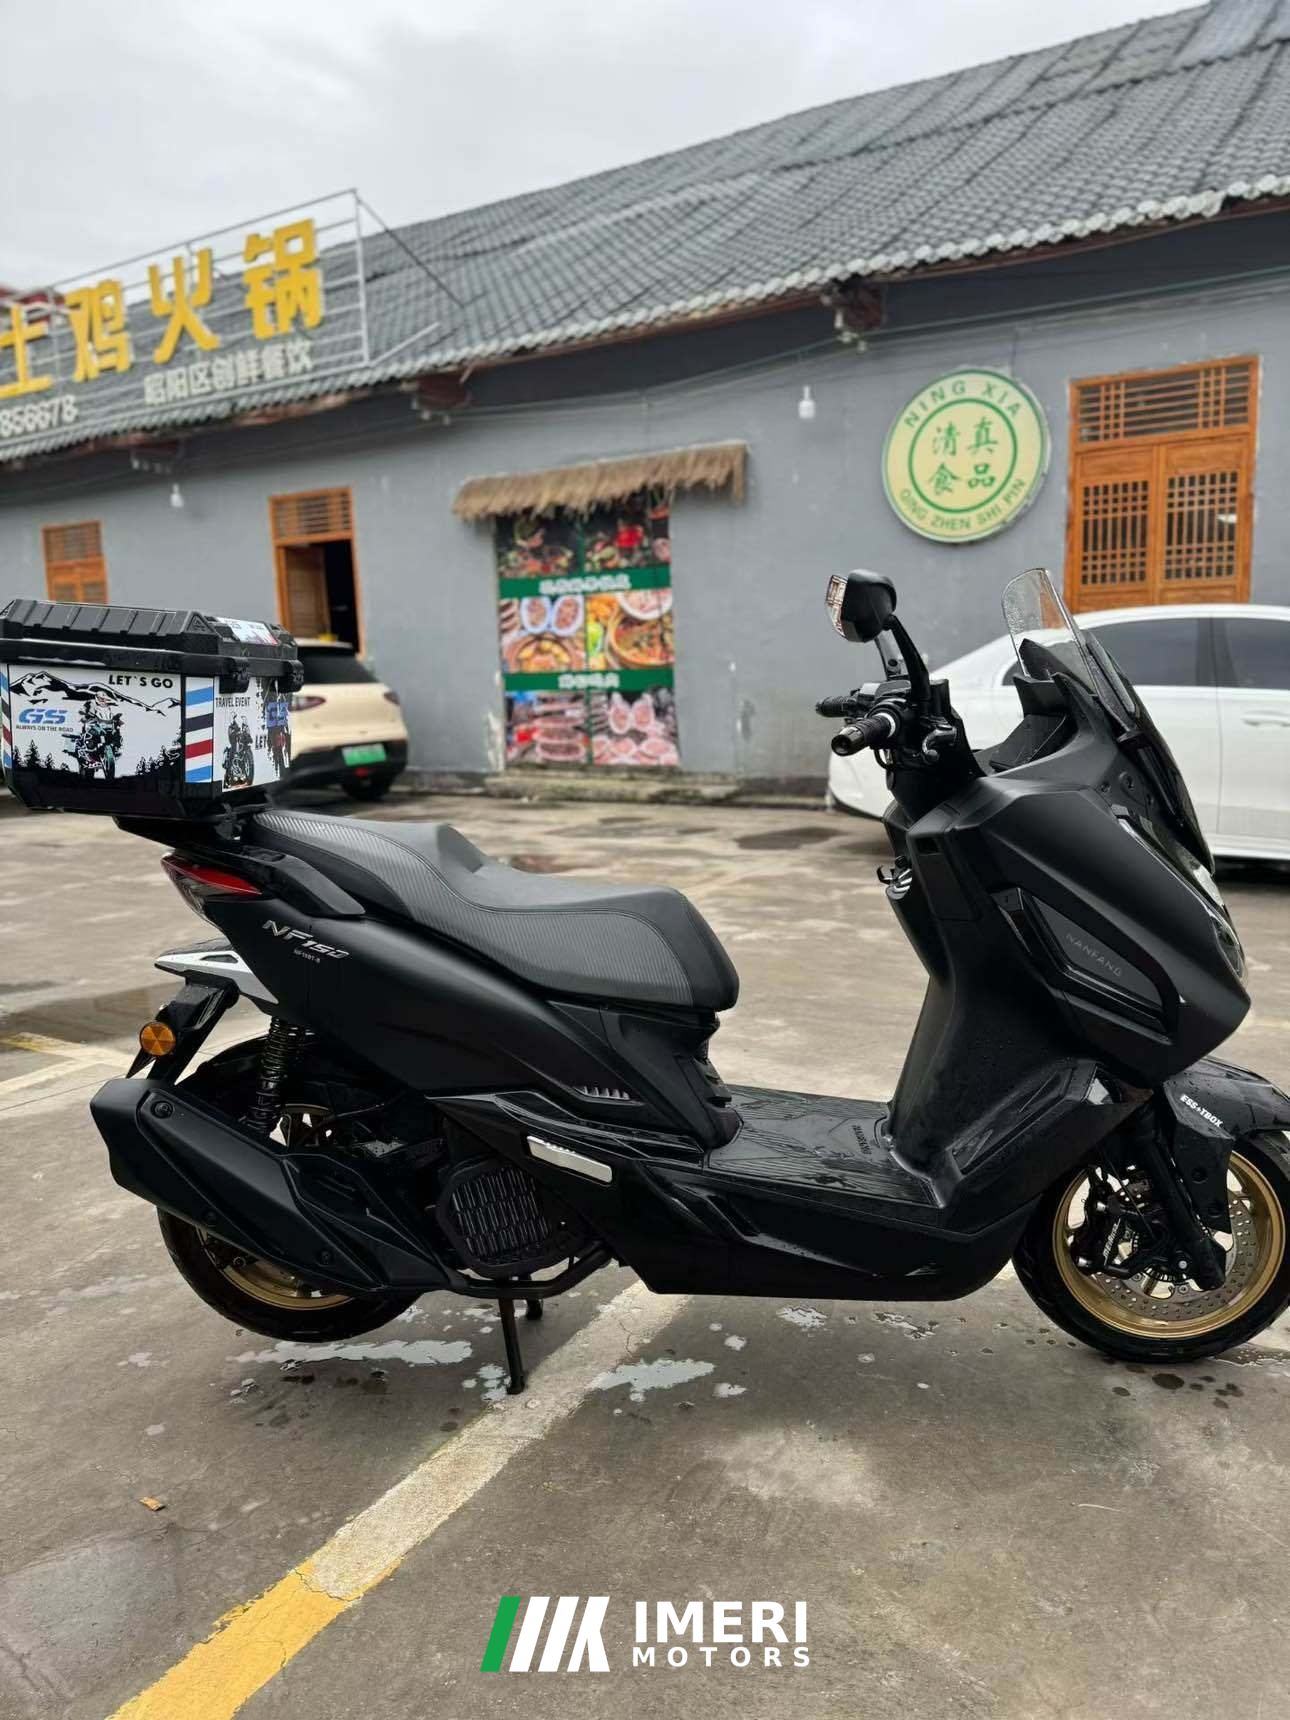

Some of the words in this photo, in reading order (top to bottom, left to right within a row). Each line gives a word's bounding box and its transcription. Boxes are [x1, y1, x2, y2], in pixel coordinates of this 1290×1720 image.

[0, 218, 325, 398] 土鸡火锅
[903, 379, 966, 428] NING
[981, 381, 1022, 418] XIA
[932, 416, 998, 456] 清真
[928, 462, 996, 496] 食品
[931, 513, 971, 530] ZHEN
[151, 677, 173, 689] GO
[19, 708, 68, 725] GS
